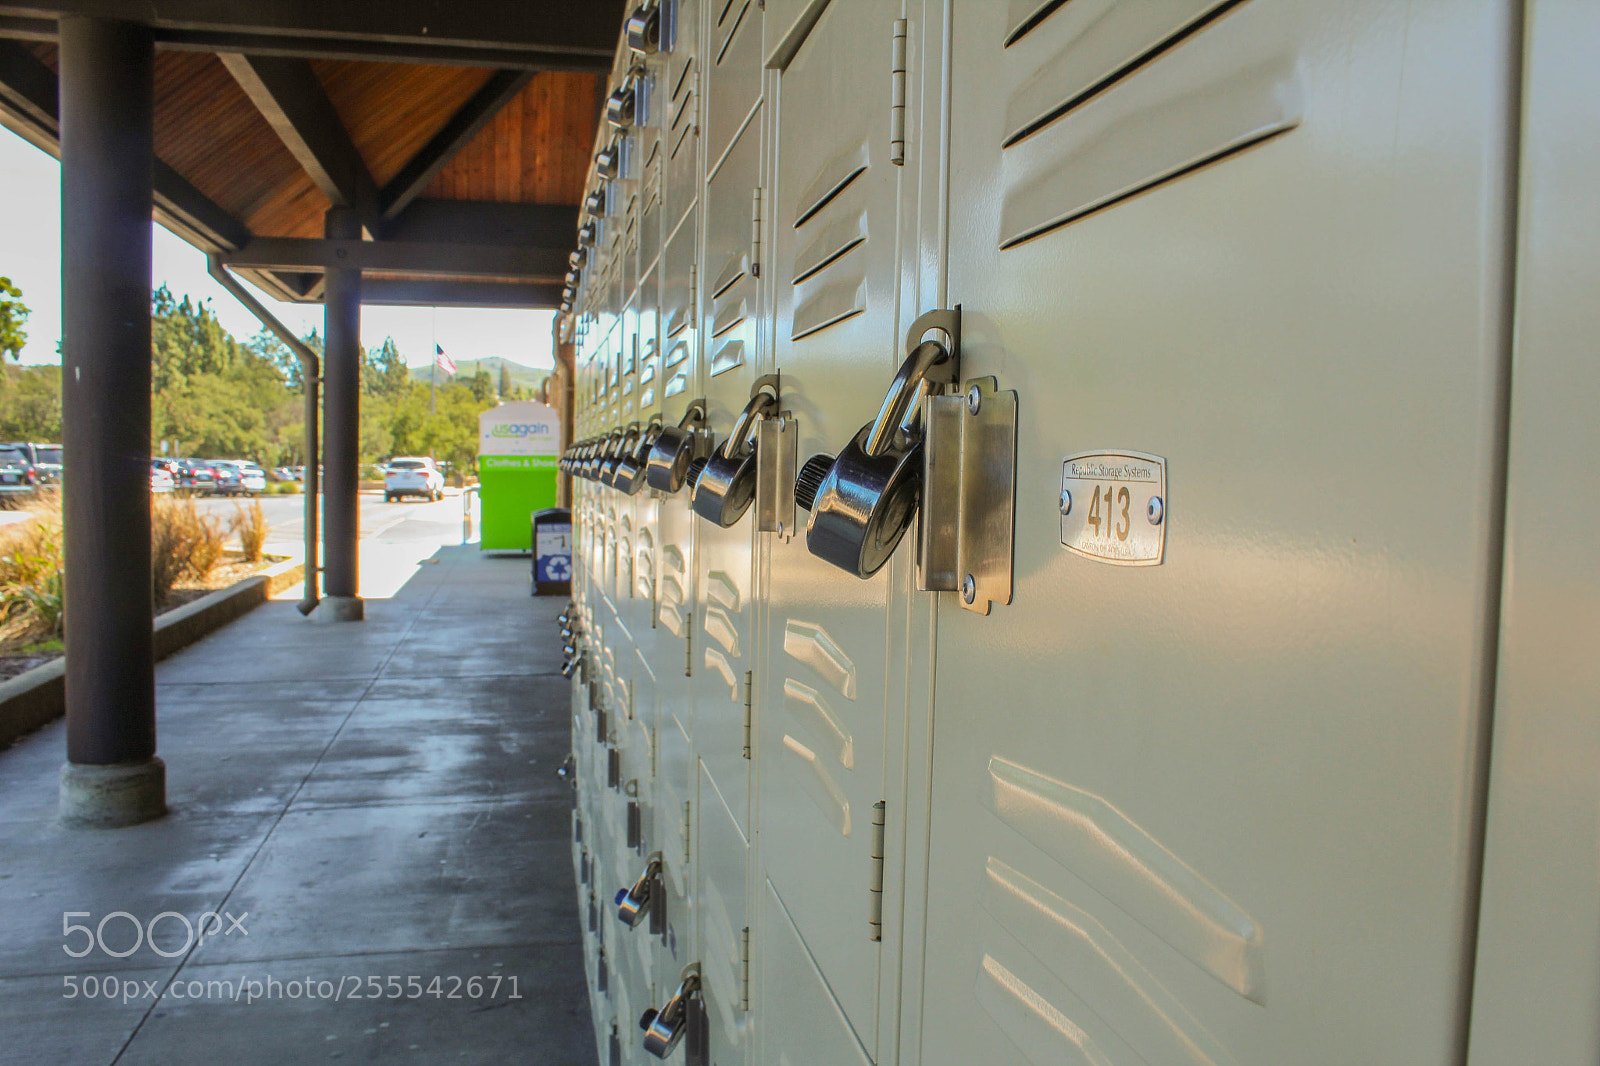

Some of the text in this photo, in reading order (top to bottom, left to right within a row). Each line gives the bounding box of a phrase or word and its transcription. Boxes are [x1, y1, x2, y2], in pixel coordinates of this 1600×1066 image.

[486, 458, 521, 468] Clothes
[524, 459, 530, 468] &
[1071, 463, 1151, 481] Republic Storage Systems
[1088, 485, 1130, 541] 413
